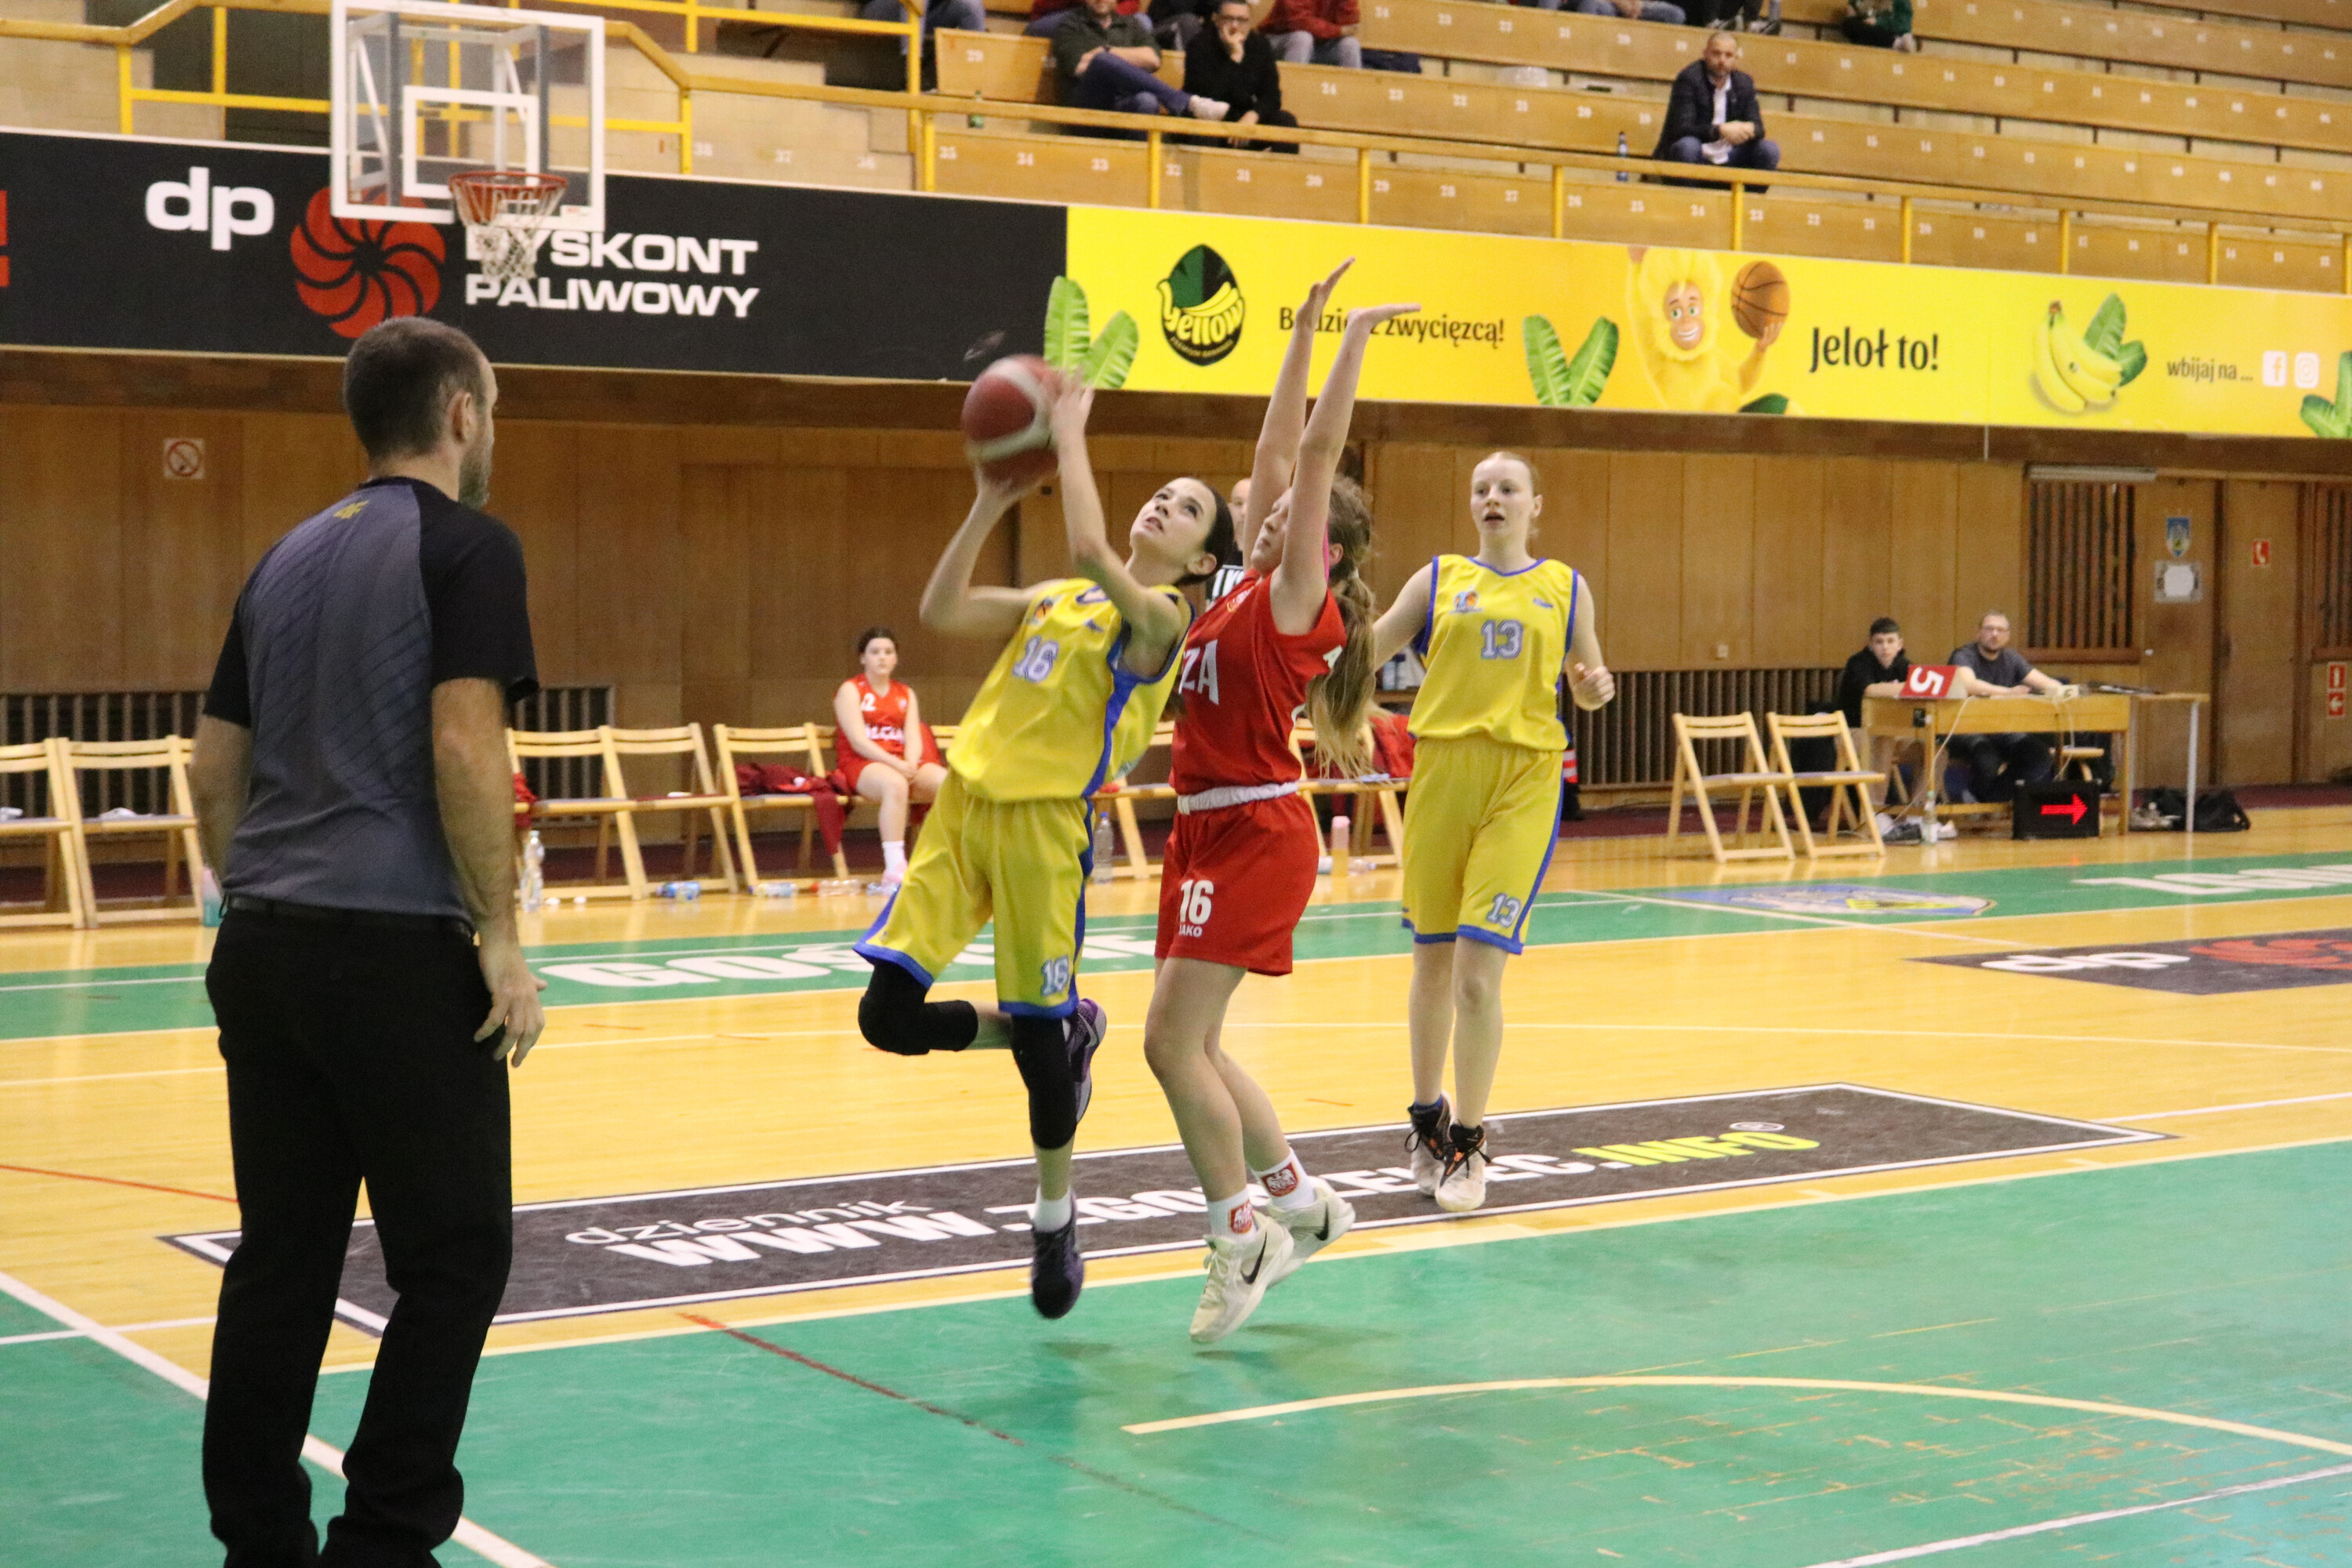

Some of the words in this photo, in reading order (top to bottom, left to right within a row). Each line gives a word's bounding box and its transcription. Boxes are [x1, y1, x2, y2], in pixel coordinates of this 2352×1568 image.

[1016, 151, 1035, 167] 34
[1091, 158, 1109, 172] 33
[145, 166, 274, 251] dp
[466, 274, 760, 318] PALIWOWY
[1157, 280, 1245, 346] yellow
[1385, 314, 1504, 349] zwycięzcą!
[1809, 325, 1889, 373] Jeloł
[1897, 333, 1939, 371] to!
[2166, 356, 2215, 383] wbijaj
[1011, 635, 1059, 684] 16
[1480, 619, 1524, 659] 13
[1909, 666, 1945, 695] 5
[1180, 879, 1214, 925] 16
[1486, 891, 1521, 928] 13
[1040, 955, 1069, 996] 16
[1980, 952, 2190, 972] dp
[564, 1200, 934, 1244] dziennik
